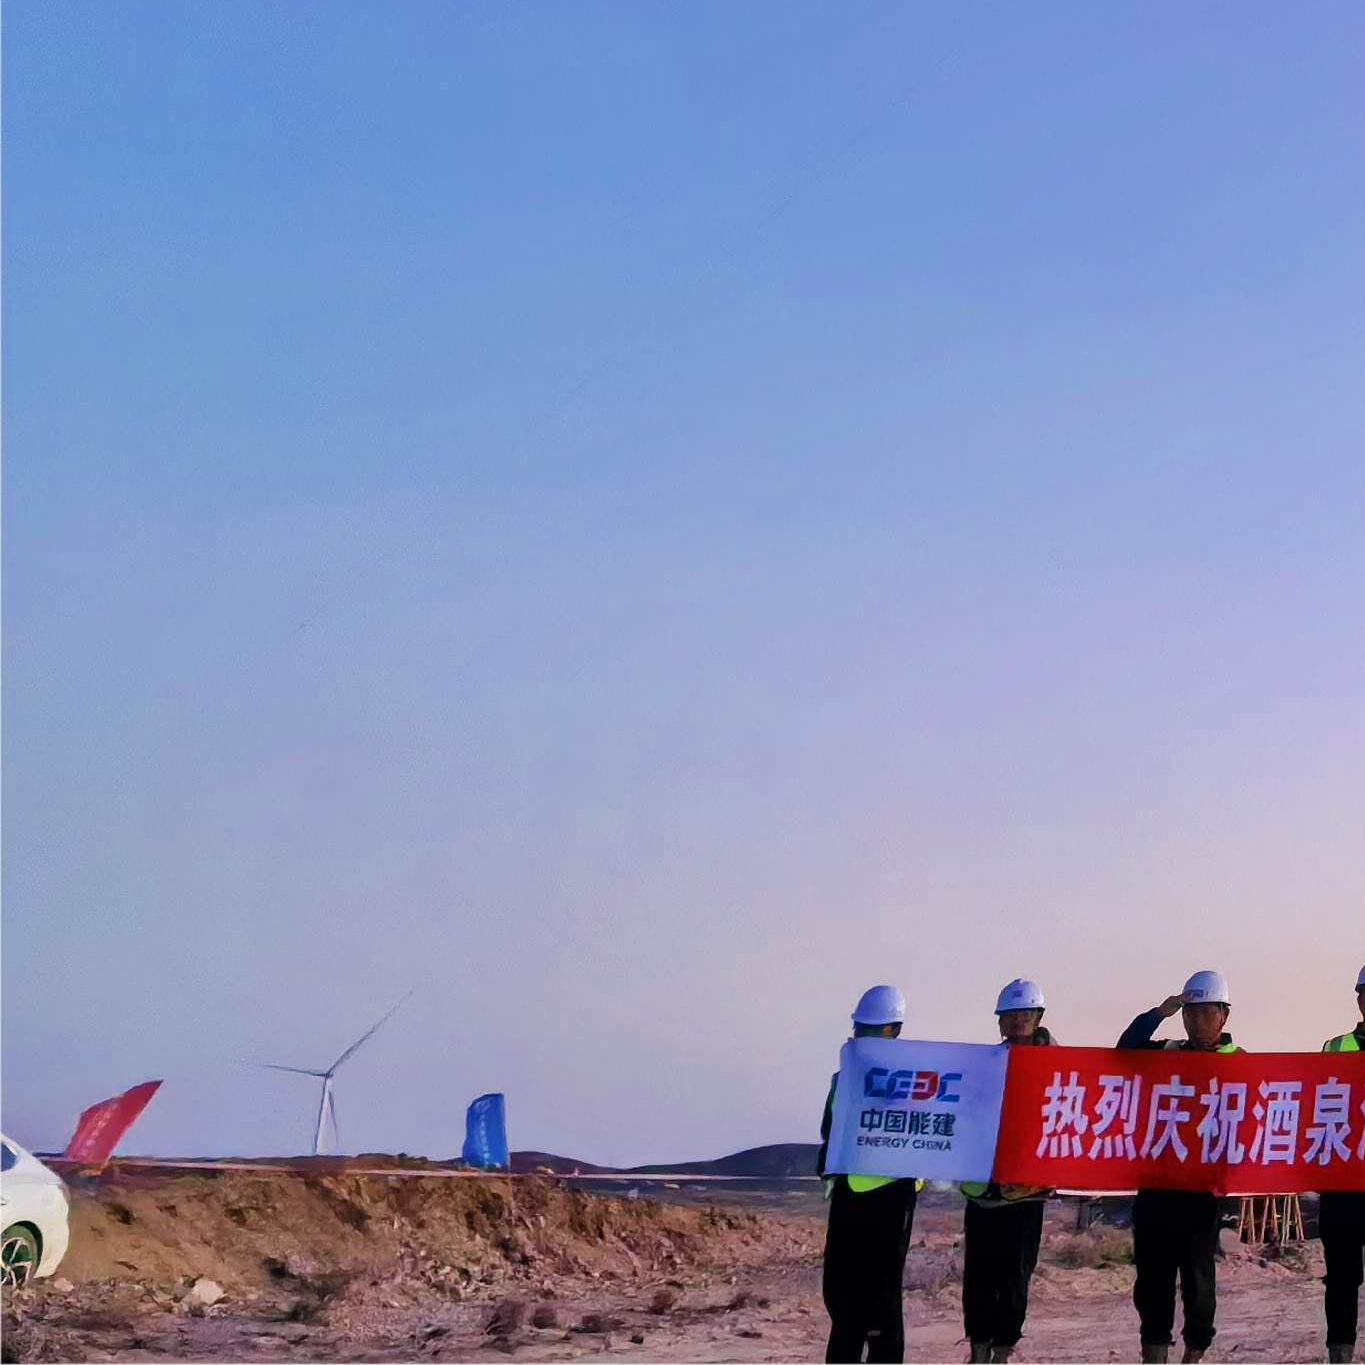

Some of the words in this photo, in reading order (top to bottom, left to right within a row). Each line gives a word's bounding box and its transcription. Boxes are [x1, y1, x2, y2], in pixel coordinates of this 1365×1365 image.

[860, 1108, 956, 1137] 中国能建
[856, 1136, 909, 1149] ENERGY
[912, 1139, 951, 1151] CHINA
